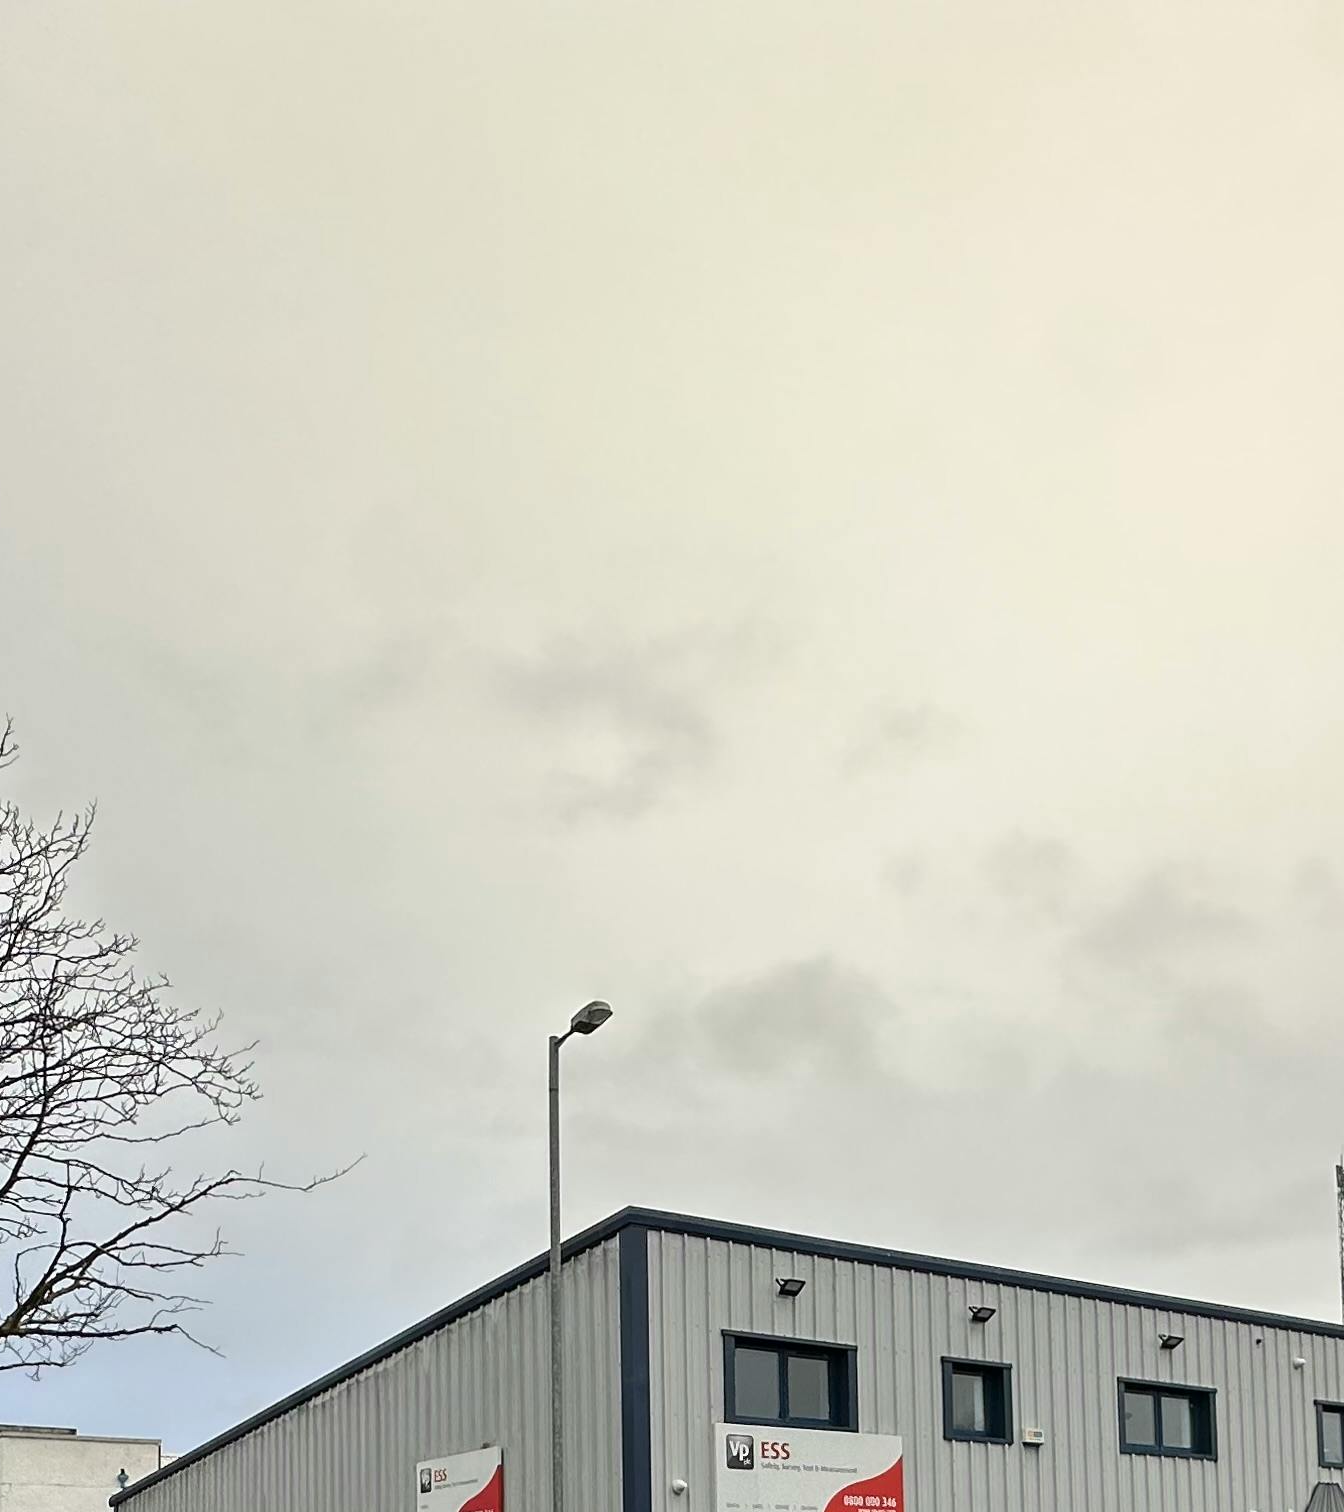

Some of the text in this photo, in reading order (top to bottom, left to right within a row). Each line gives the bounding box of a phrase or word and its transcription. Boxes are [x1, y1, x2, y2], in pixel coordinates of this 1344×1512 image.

[729, 1440, 749, 1461] Vp
[760, 1441, 791, 1460] ESS
[434, 1468, 448, 1483] ESS
[881, 1496, 897, 1508] 346
